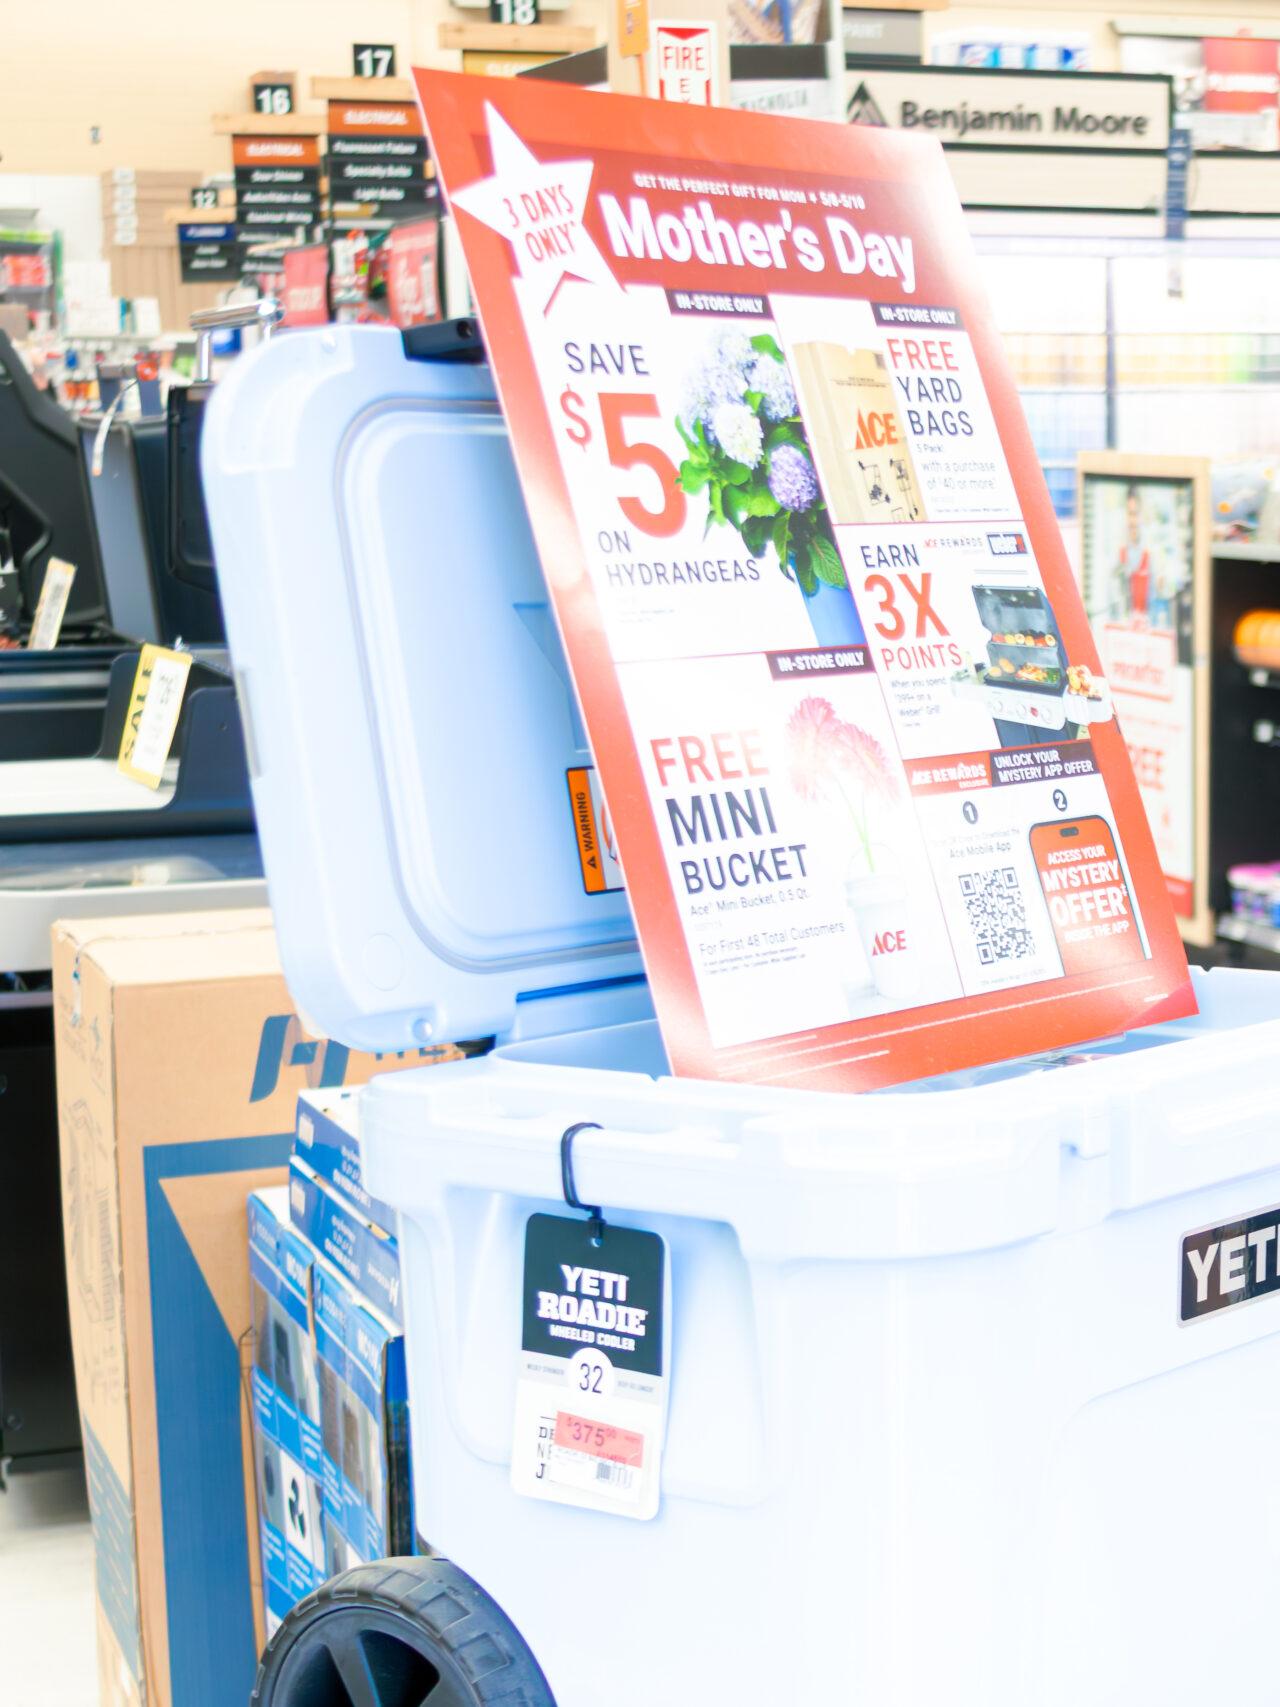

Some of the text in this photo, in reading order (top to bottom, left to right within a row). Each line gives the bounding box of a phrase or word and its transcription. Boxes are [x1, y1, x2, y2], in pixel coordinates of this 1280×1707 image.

[495, 0, 536, 25] 18
[356, 50, 393, 79] 17
[663, 46, 705, 71] FIRE
[257, 87, 291, 115] 16
[900, 100, 1148, 137] Benjamin Moore
[194, 190, 217, 210] 12
[634, 173, 658, 188] GET
[658, 176, 682, 191] THE
[683, 179, 730, 197] PERFECT
[731, 184, 756, 199] GIFT
[757, 187, 780, 202] FOR
[780, 190, 807, 205] MOM
[503, 184, 573, 228] 3 DAYS
[598, 192, 917, 295] Mother's Day
[675, 293, 764, 314] IN-STORE ONLY
[879, 306, 957, 325] IN-STORE ONLY
[564, 342, 650, 375] SAVE
[886, 338, 960, 372] FREE
[896, 376, 963, 403] YARD
[855, 408, 899, 450] ACE
[907, 409, 974, 437] BAGS
[952, 460, 997, 475] purchase
[598, 531, 632, 553] ON
[939, 535, 984, 548] REWARDS
[861, 545, 920, 568] EARN
[605, 559, 761, 587] HYDRANGEAS
[864, 572, 952, 641] 3X
[776, 650, 866, 673] IN-STORE ONLY
[880, 642, 964, 671] POINTS
[650, 728, 771, 788] FREE
[994, 750, 1061, 769] UNLOCK YOUR
[998, 759, 1094, 784] MYSTERY APP OFFER
[912, 763, 987, 786] ACE REWARDS
[576, 791, 595, 852] WARNING
[665, 786, 778, 847] MINI
[1047, 844, 1106, 865] ACCESS YOUR
[679, 843, 808, 895] BUCKET
[1041, 860, 1121, 892] MYSTERY
[716, 899, 739, 913] Mini
[699, 921, 846, 956] For First 48 Total Customers
[1110, 920, 1130, 936] APP
[872, 930, 908, 957] ACE
[560, 1264, 629, 1302] YETI
[537, 1291, 648, 1338] ROADIE
[549, 1324, 637, 1352] WHEELED COOLER
[578, 1362, 604, 1395] 32
